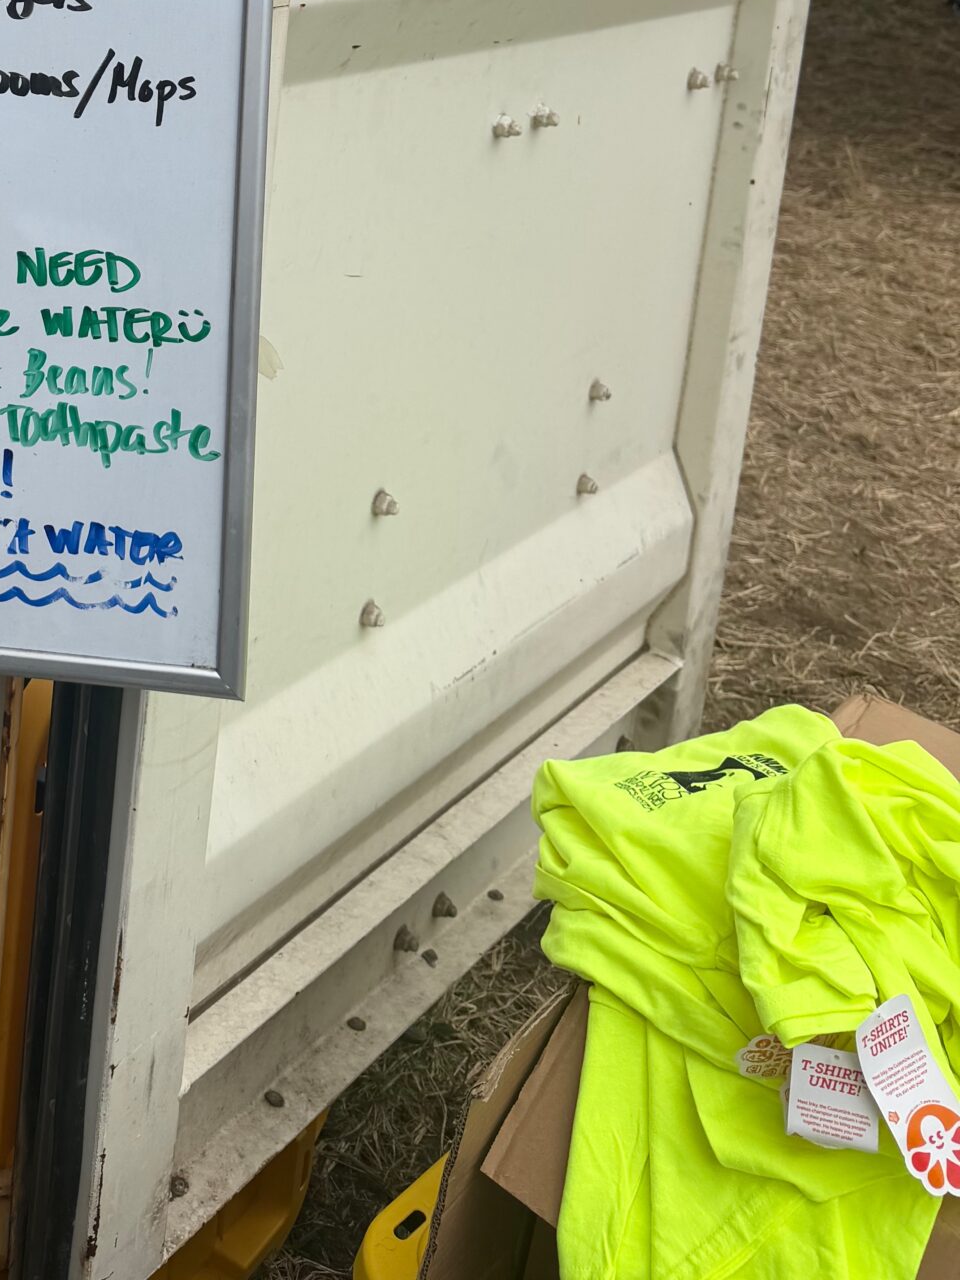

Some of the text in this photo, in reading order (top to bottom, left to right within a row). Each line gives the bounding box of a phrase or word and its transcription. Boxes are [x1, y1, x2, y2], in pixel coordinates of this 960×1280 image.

[16, 247, 142, 293] NEED
[861, 1010, 909, 1049] T-SHIRTS
[808, 1074, 862, 1097] UNITE!
